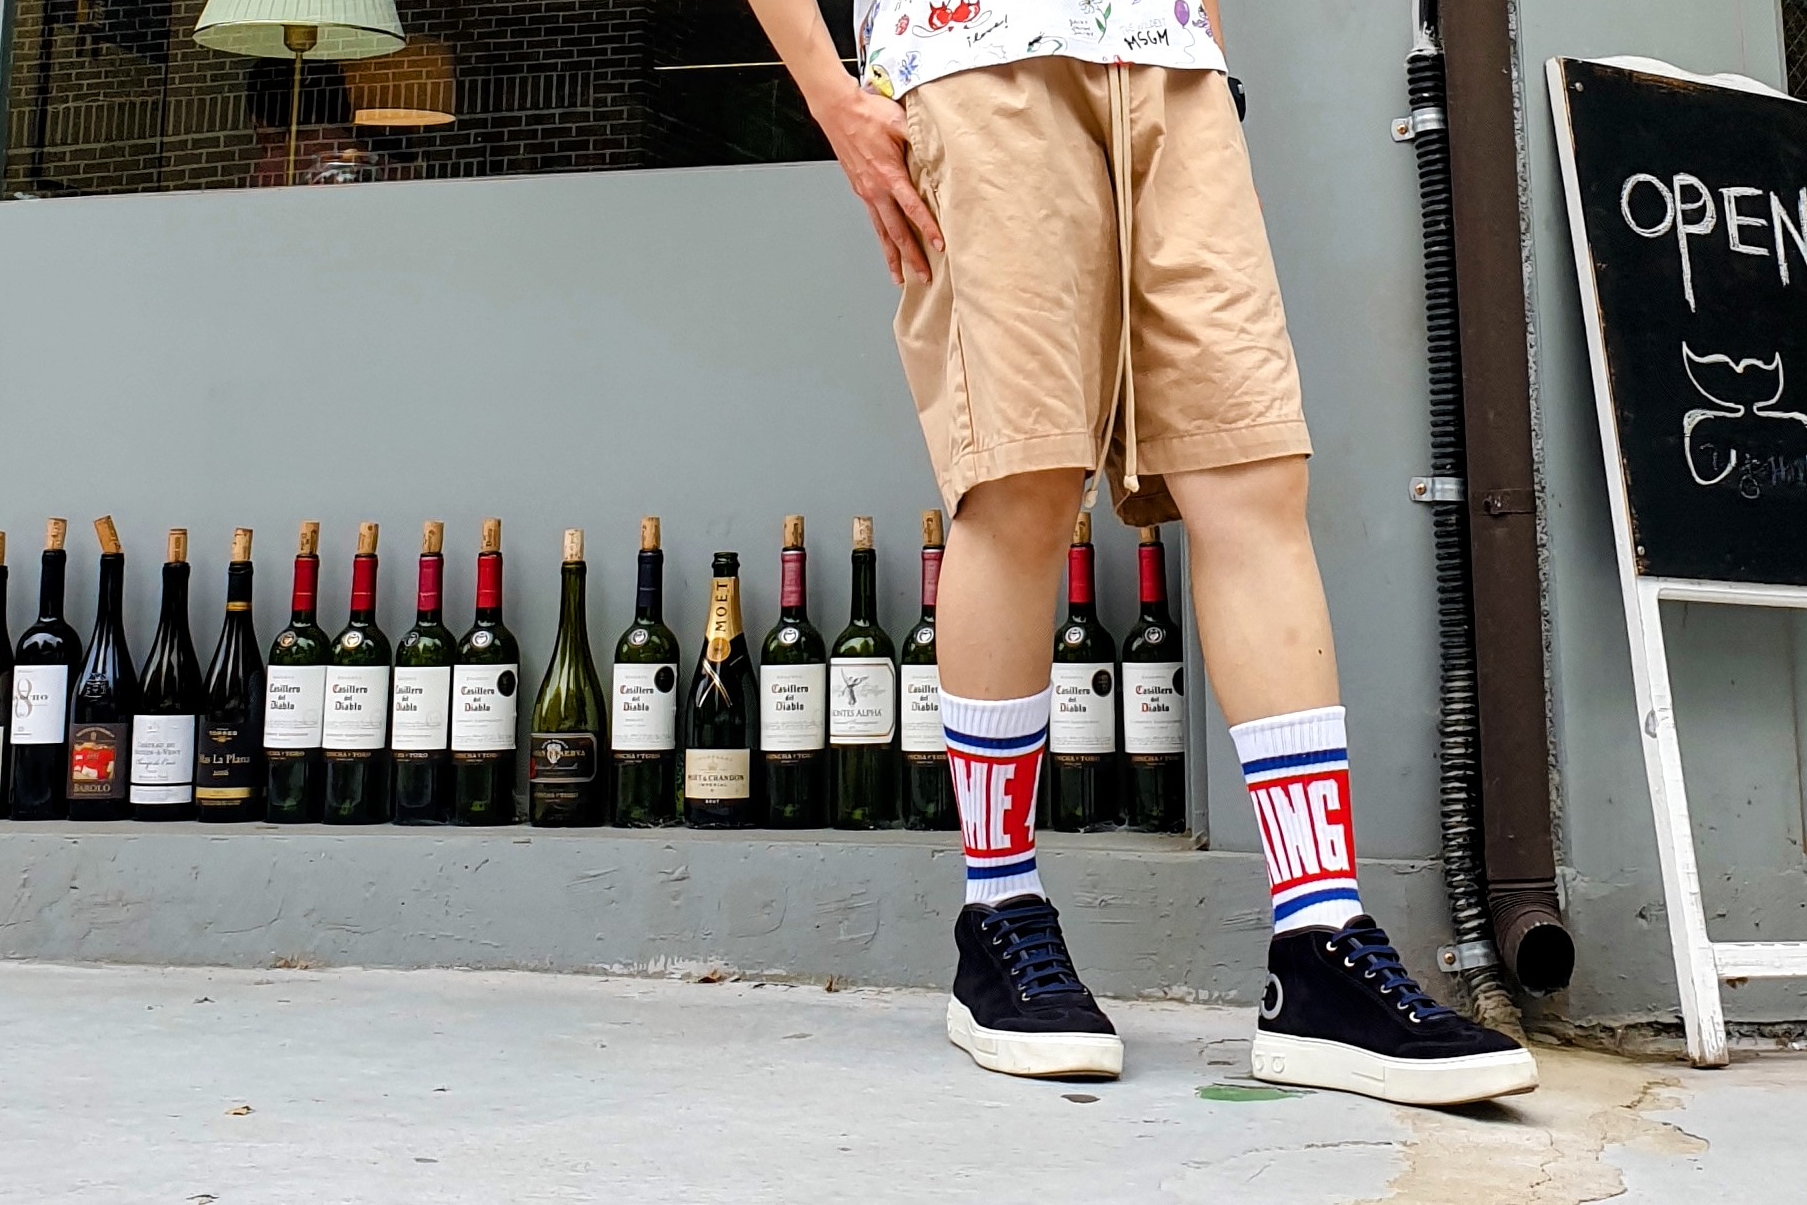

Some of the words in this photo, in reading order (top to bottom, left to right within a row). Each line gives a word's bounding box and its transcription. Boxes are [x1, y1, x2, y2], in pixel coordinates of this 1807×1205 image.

[1123, 28, 1169, 50] MSGM
[1620, 172, 1807, 313] OPEN
[213, 754, 224, 763] La
[708, 774, 745, 782] CHANDON
